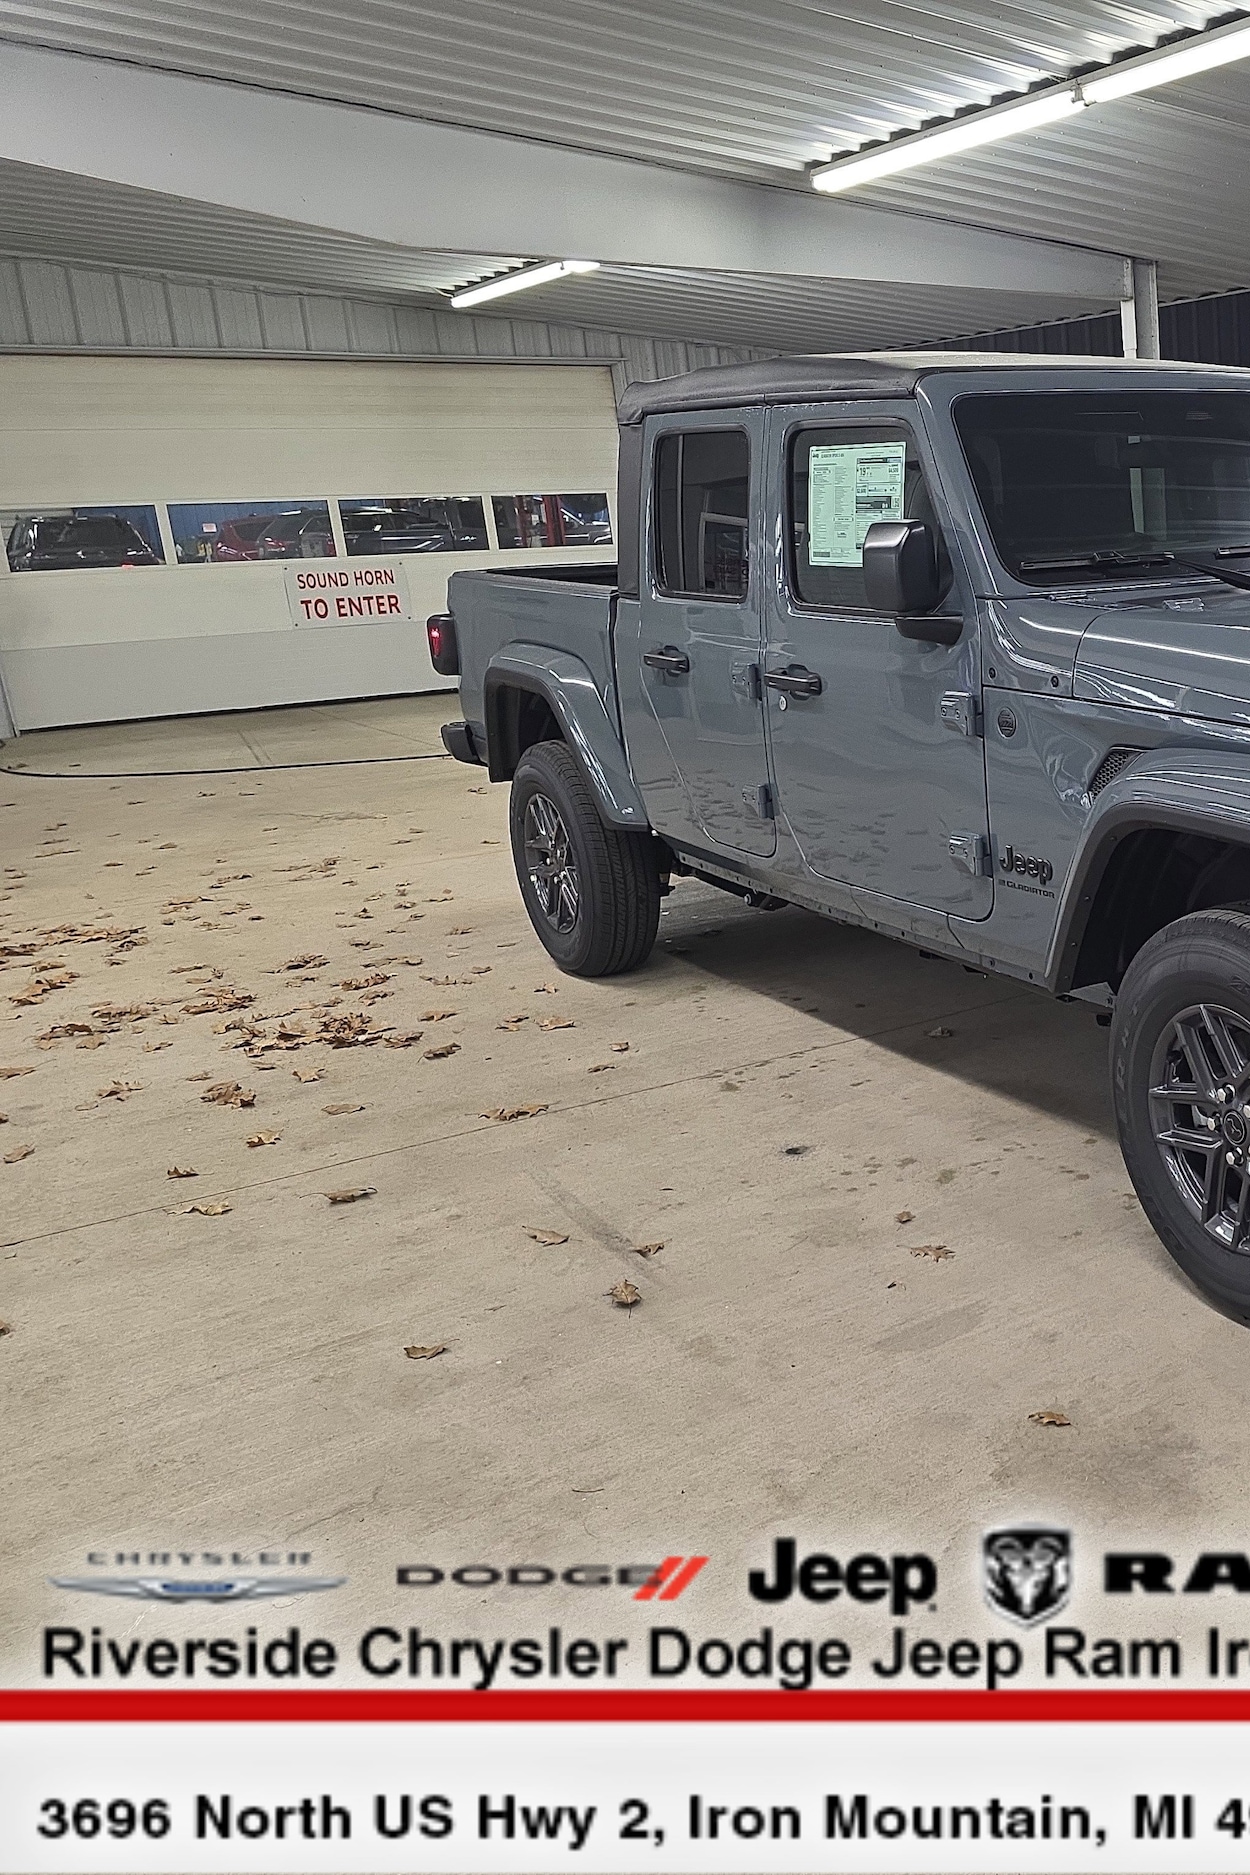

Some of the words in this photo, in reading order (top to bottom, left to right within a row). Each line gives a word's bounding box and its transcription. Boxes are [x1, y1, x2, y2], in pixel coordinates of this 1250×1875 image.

[296, 571, 349, 590] SOUND
[353, 568, 395, 587] HORN
[300, 597, 329, 620] TO
[335, 593, 402, 618] ENTER
[999, 844, 1053, 886] Jeep
[1006, 880, 1055, 899] GLADIATOR
